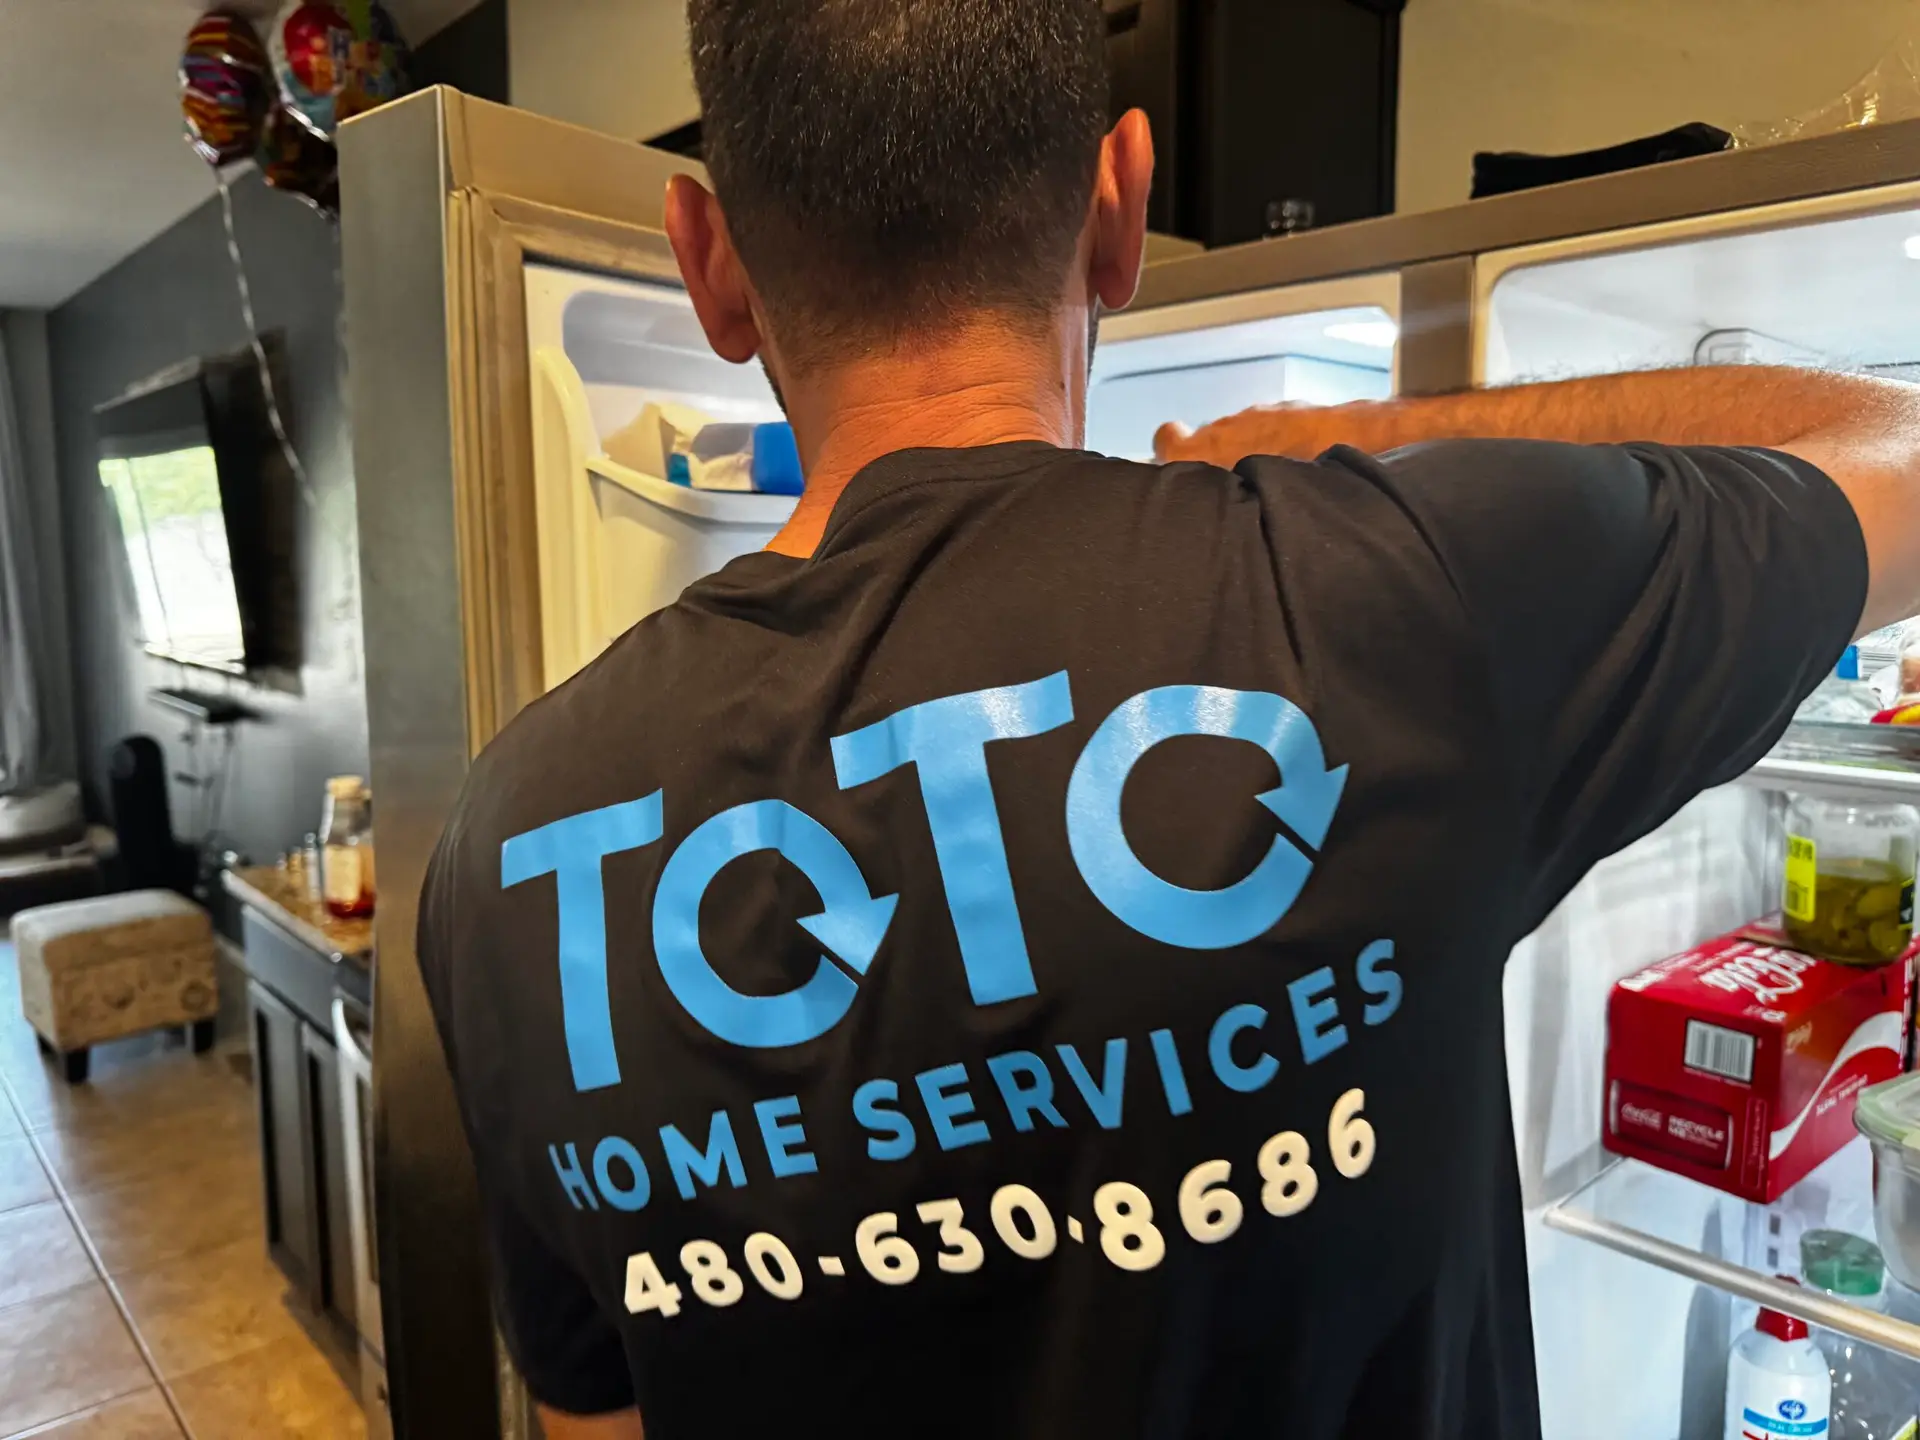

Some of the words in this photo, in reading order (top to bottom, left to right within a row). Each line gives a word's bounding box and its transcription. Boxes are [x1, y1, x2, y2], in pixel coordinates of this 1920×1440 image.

[500, 670, 1349, 1092] TOTO
[548, 1095, 818, 1211] HOME
[853, 938, 1402, 1161] SERVICES
[624, 1088, 1375, 1318] 480-630-8686
